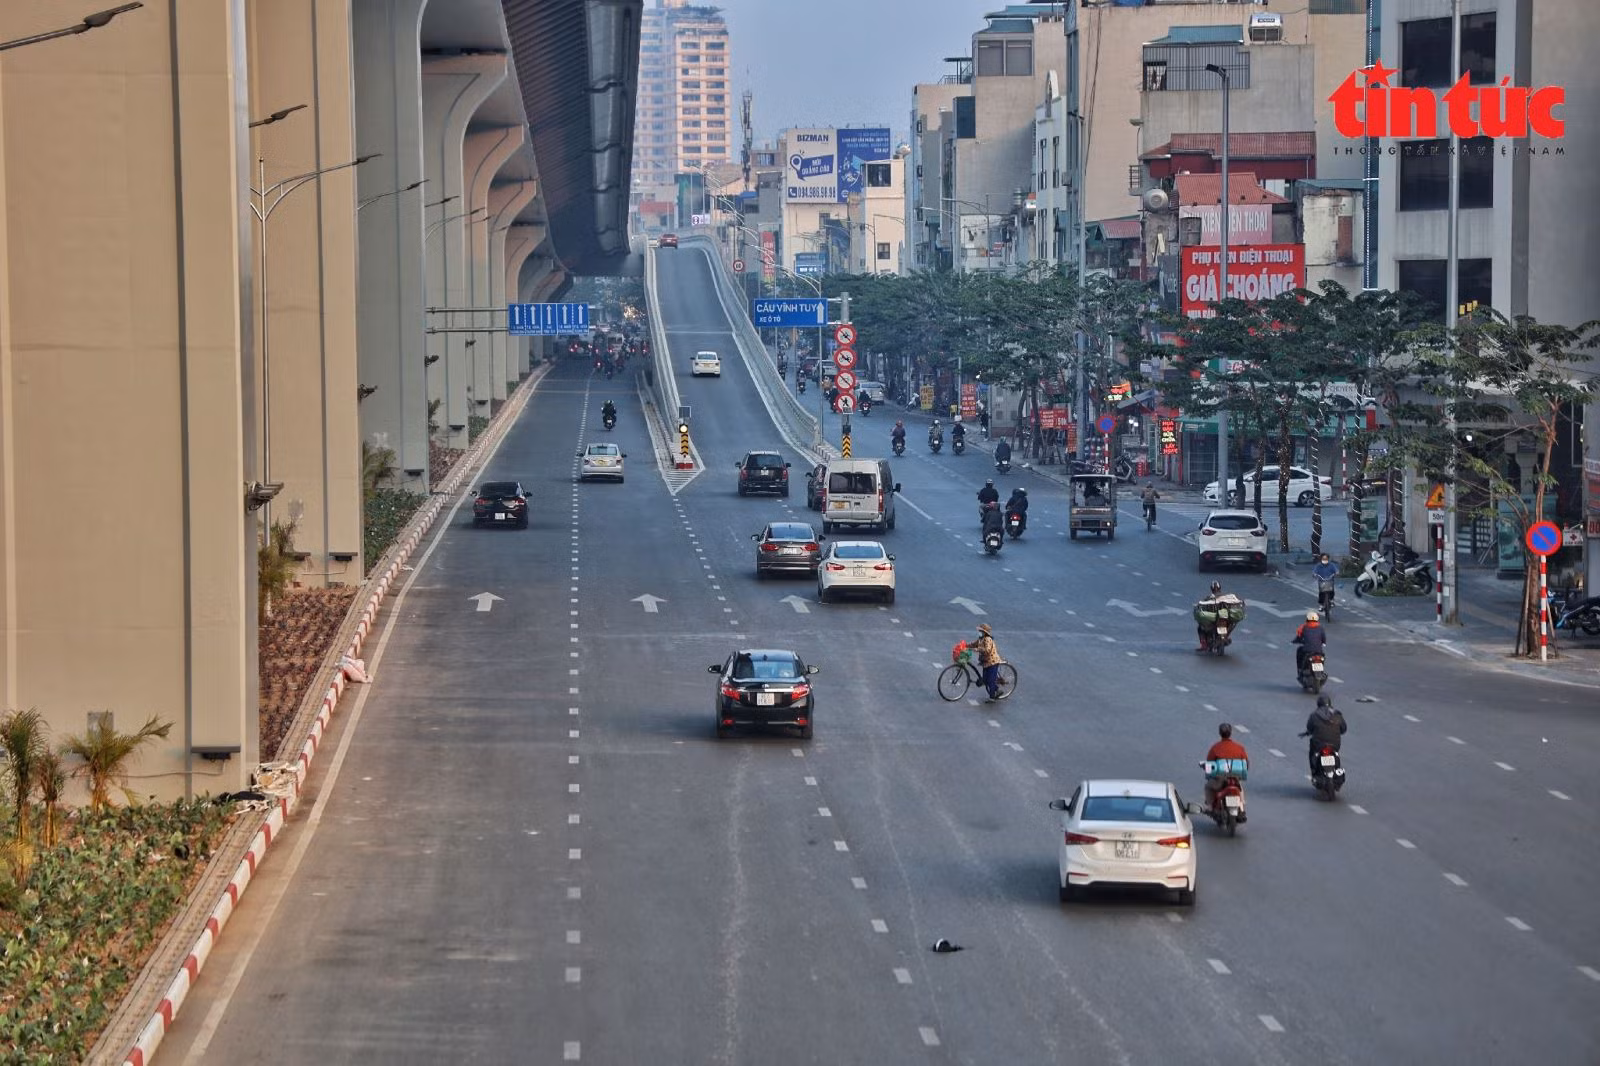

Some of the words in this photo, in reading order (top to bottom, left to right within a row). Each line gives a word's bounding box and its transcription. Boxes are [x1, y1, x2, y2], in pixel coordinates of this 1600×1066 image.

[797, 134, 829, 142] BIZMAN
[1244, 210, 1267, 236] THOẠI
[1191, 251, 1211, 266] PHỤ
[1239, 248, 1262, 265] ĐIỆN
[1264, 250, 1293, 265] THOẠI
[1186, 269, 1219, 302] GIÁ
[1226, 268, 1297, 301] CHOÁNG
[756, 302, 775, 312] CẦU
[777, 302, 798, 312] VĨNH
[799, 303, 818, 312] TUY
